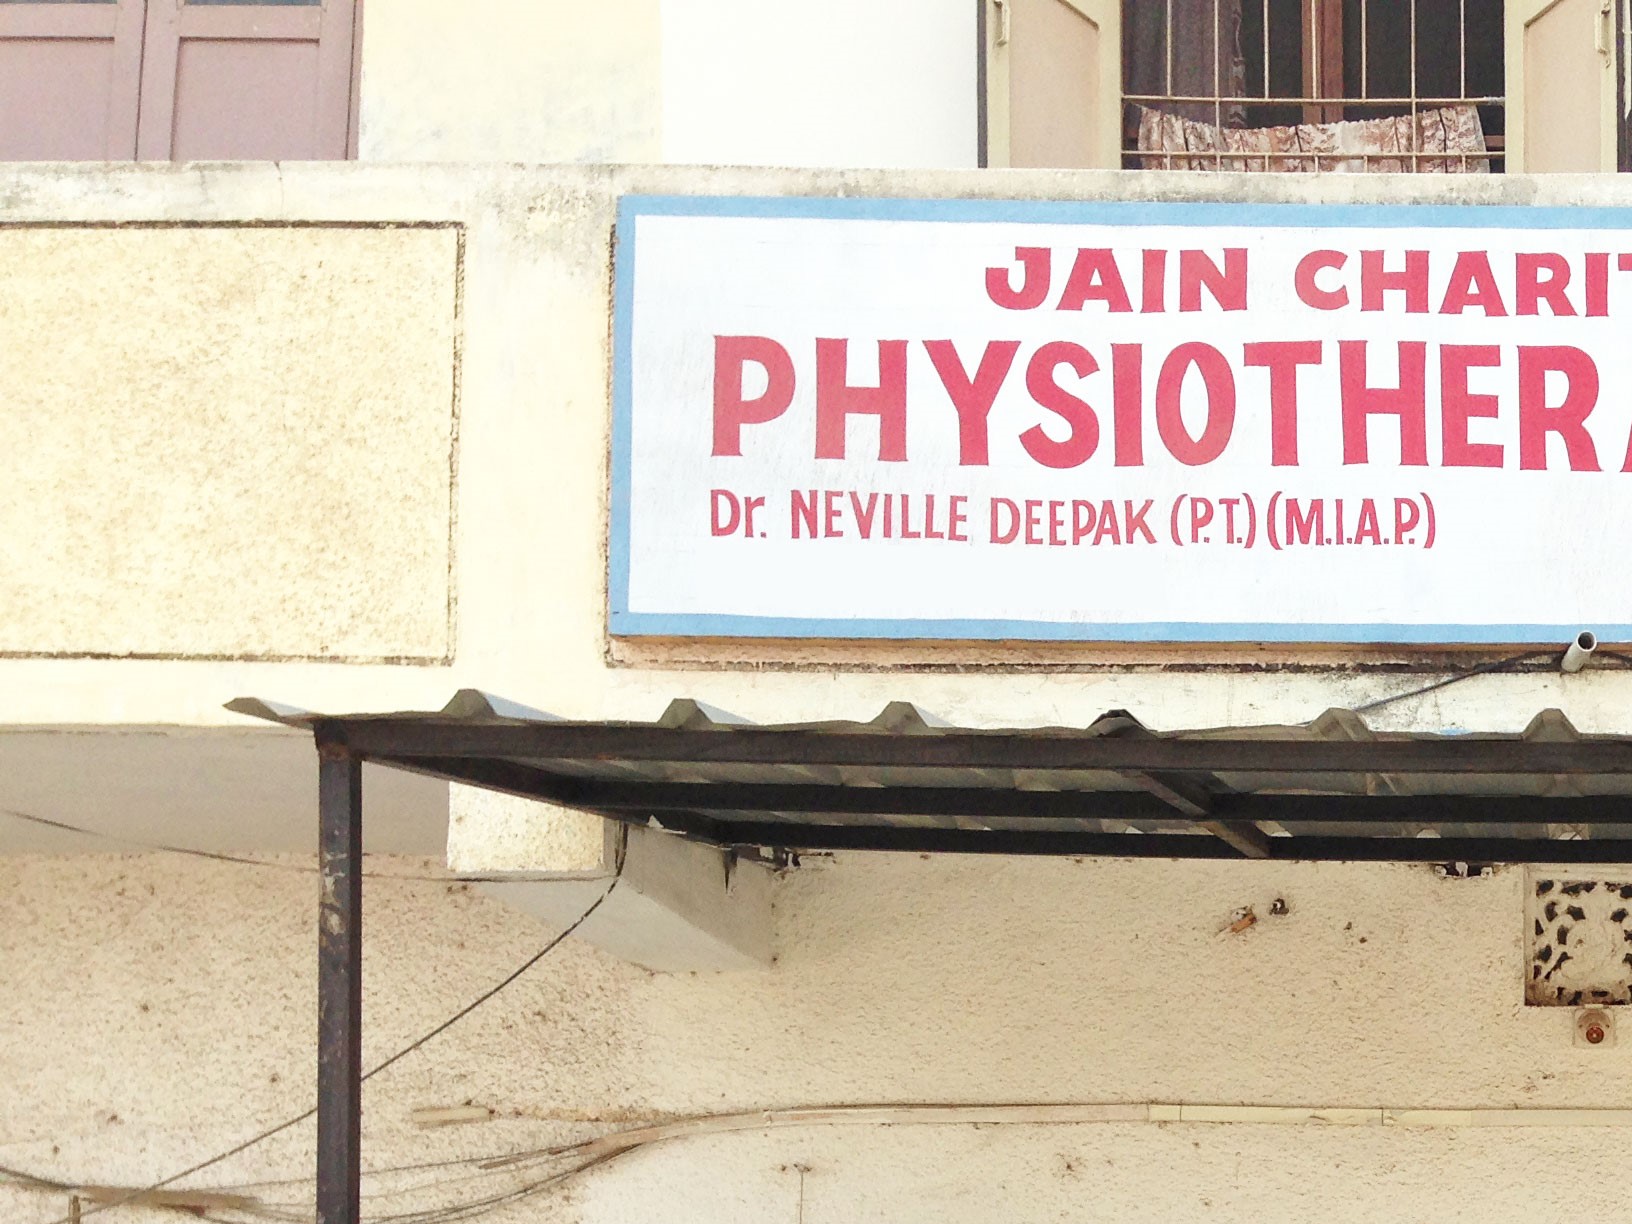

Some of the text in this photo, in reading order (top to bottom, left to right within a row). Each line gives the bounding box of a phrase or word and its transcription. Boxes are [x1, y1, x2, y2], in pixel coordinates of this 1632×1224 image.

[985, 246, 1250, 312] JAIN
[709, 488, 768, 540] Dr.
[790, 490, 969, 543] NEVILLE
[989, 496, 1158, 546] DEEPAK
